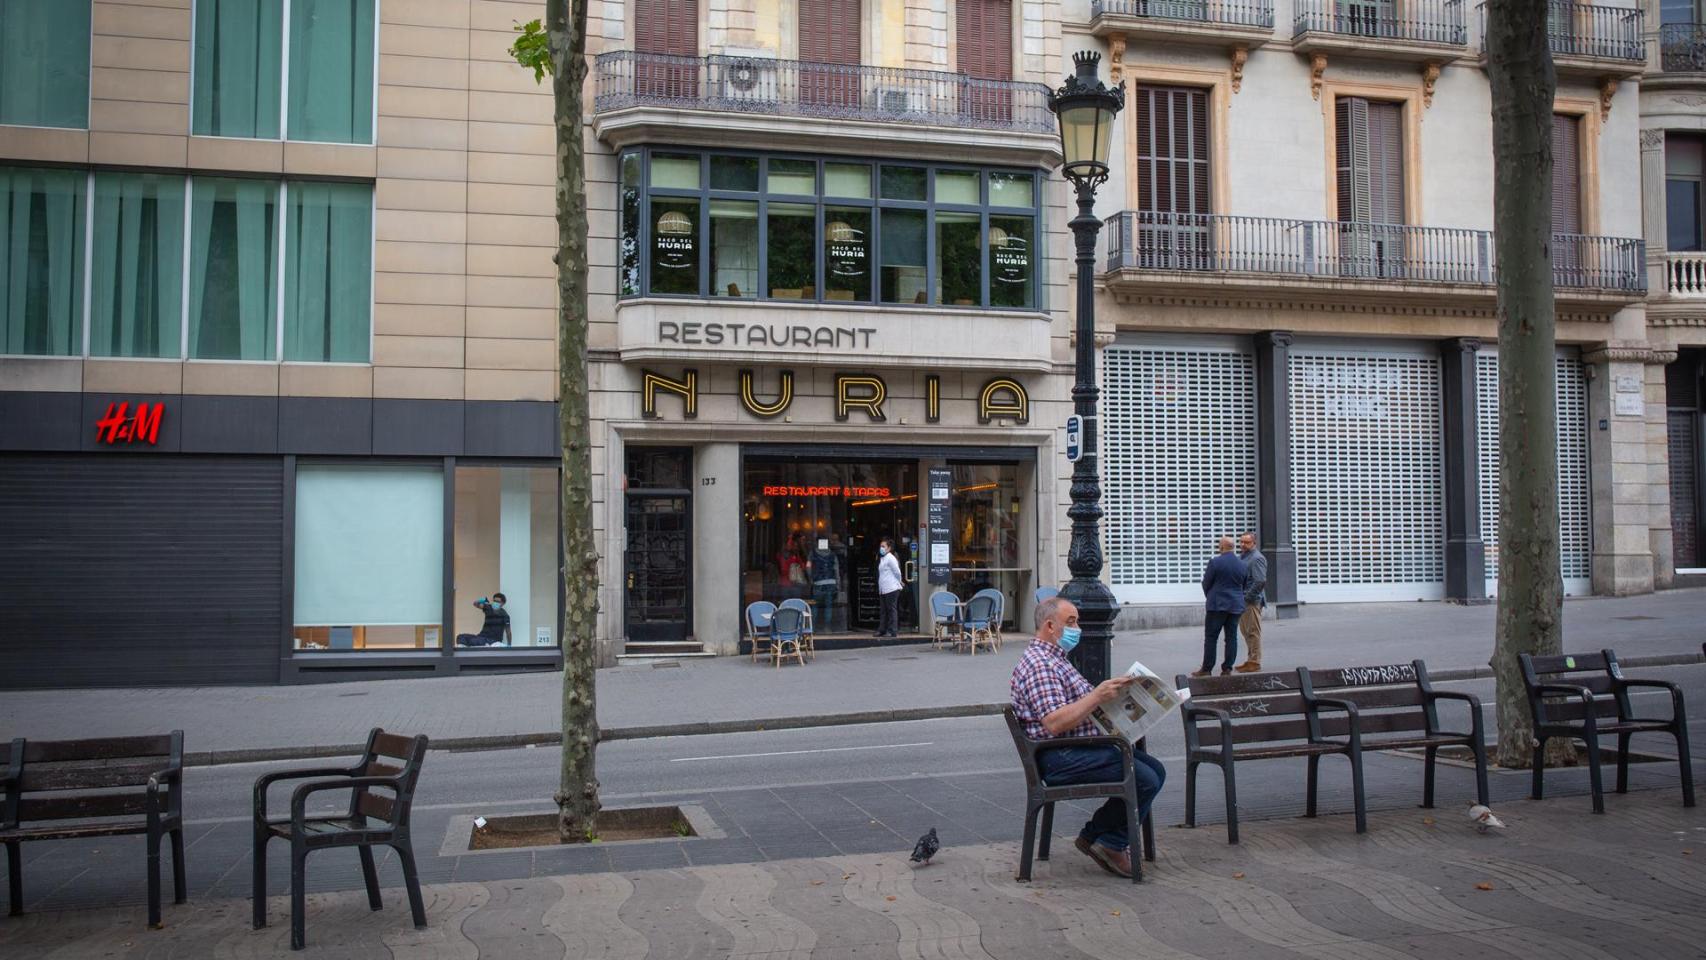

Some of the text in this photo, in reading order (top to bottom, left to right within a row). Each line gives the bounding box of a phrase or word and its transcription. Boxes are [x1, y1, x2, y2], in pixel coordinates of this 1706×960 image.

[657, 242, 692, 250] NURIA
[659, 321, 877, 349] RESTAURANT
[642, 368, 1029, 425] NURIA
[96, 401, 165, 446] H&M
[702, 477, 716, 486] 133
[763, 486, 890, 497] RESTAURANT & TAPAS
